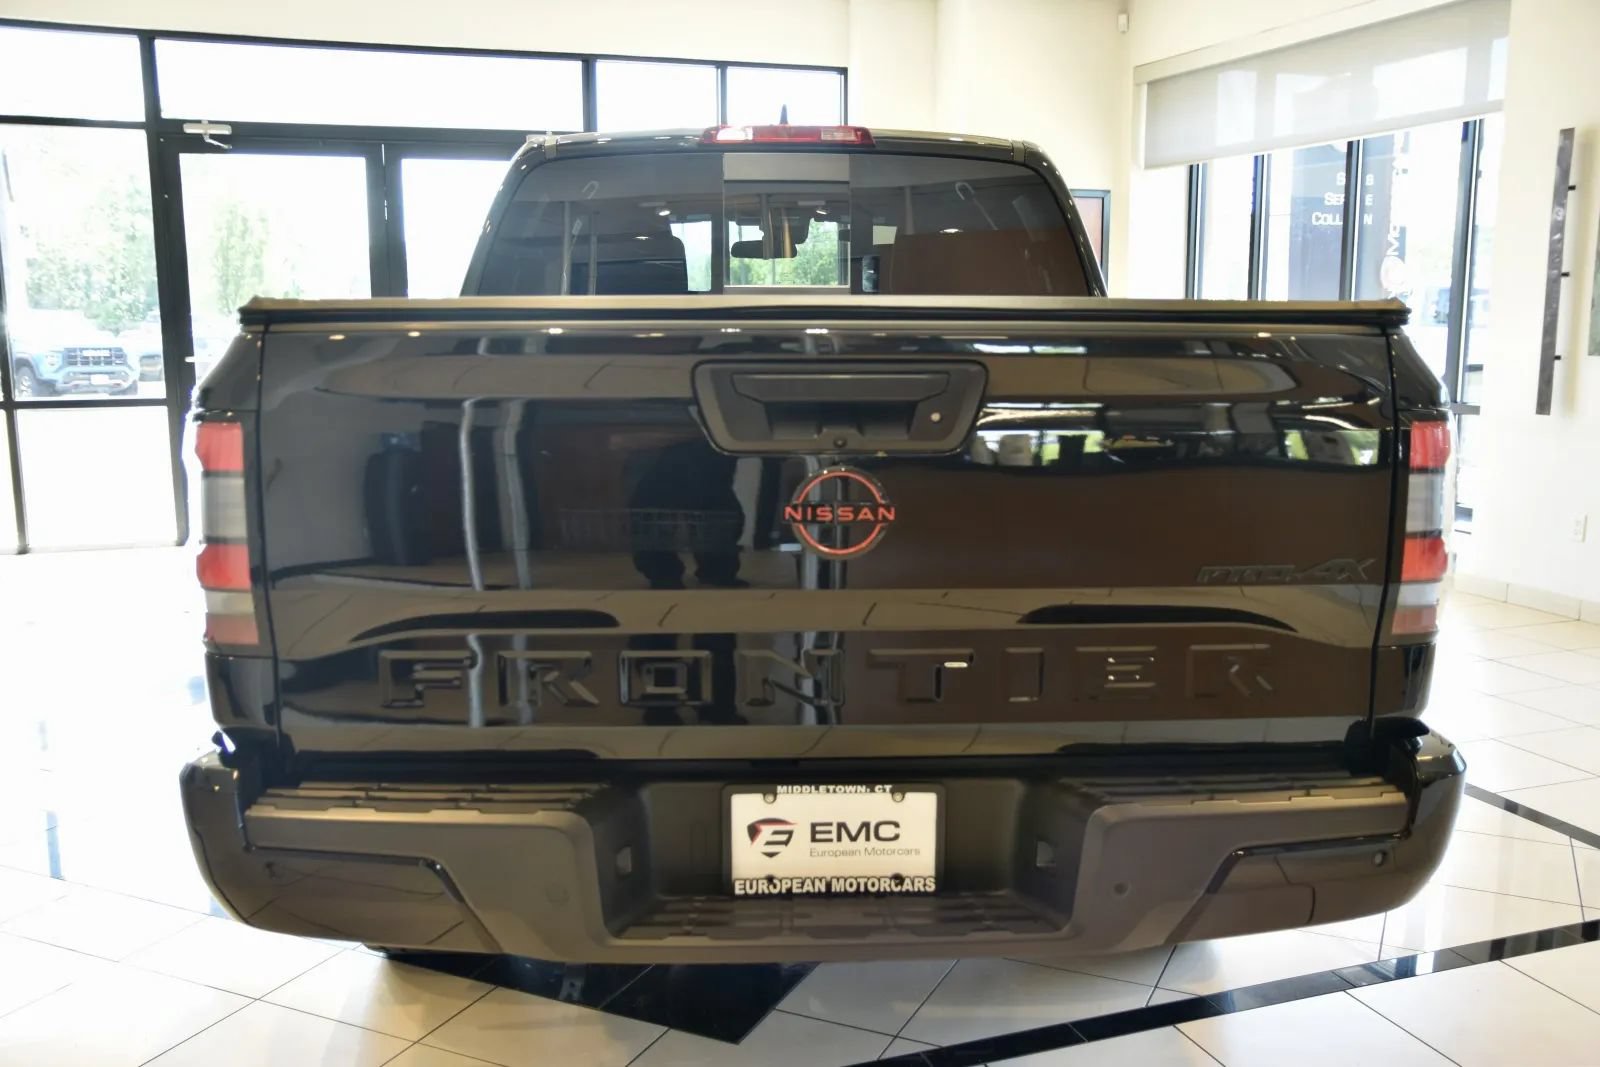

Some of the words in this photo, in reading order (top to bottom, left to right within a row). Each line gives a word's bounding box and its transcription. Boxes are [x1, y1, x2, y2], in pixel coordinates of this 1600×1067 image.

[784, 506, 896, 521] NISSAN
[379, 645, 1274, 707] FRONTIER
[874, 784, 893, 793] CT
[810, 820, 901, 843] EMC
[809, 847, 861, 858] European
[864, 846, 921, 857] Motorcars
[734, 877, 826, 895] EUROPEAN
